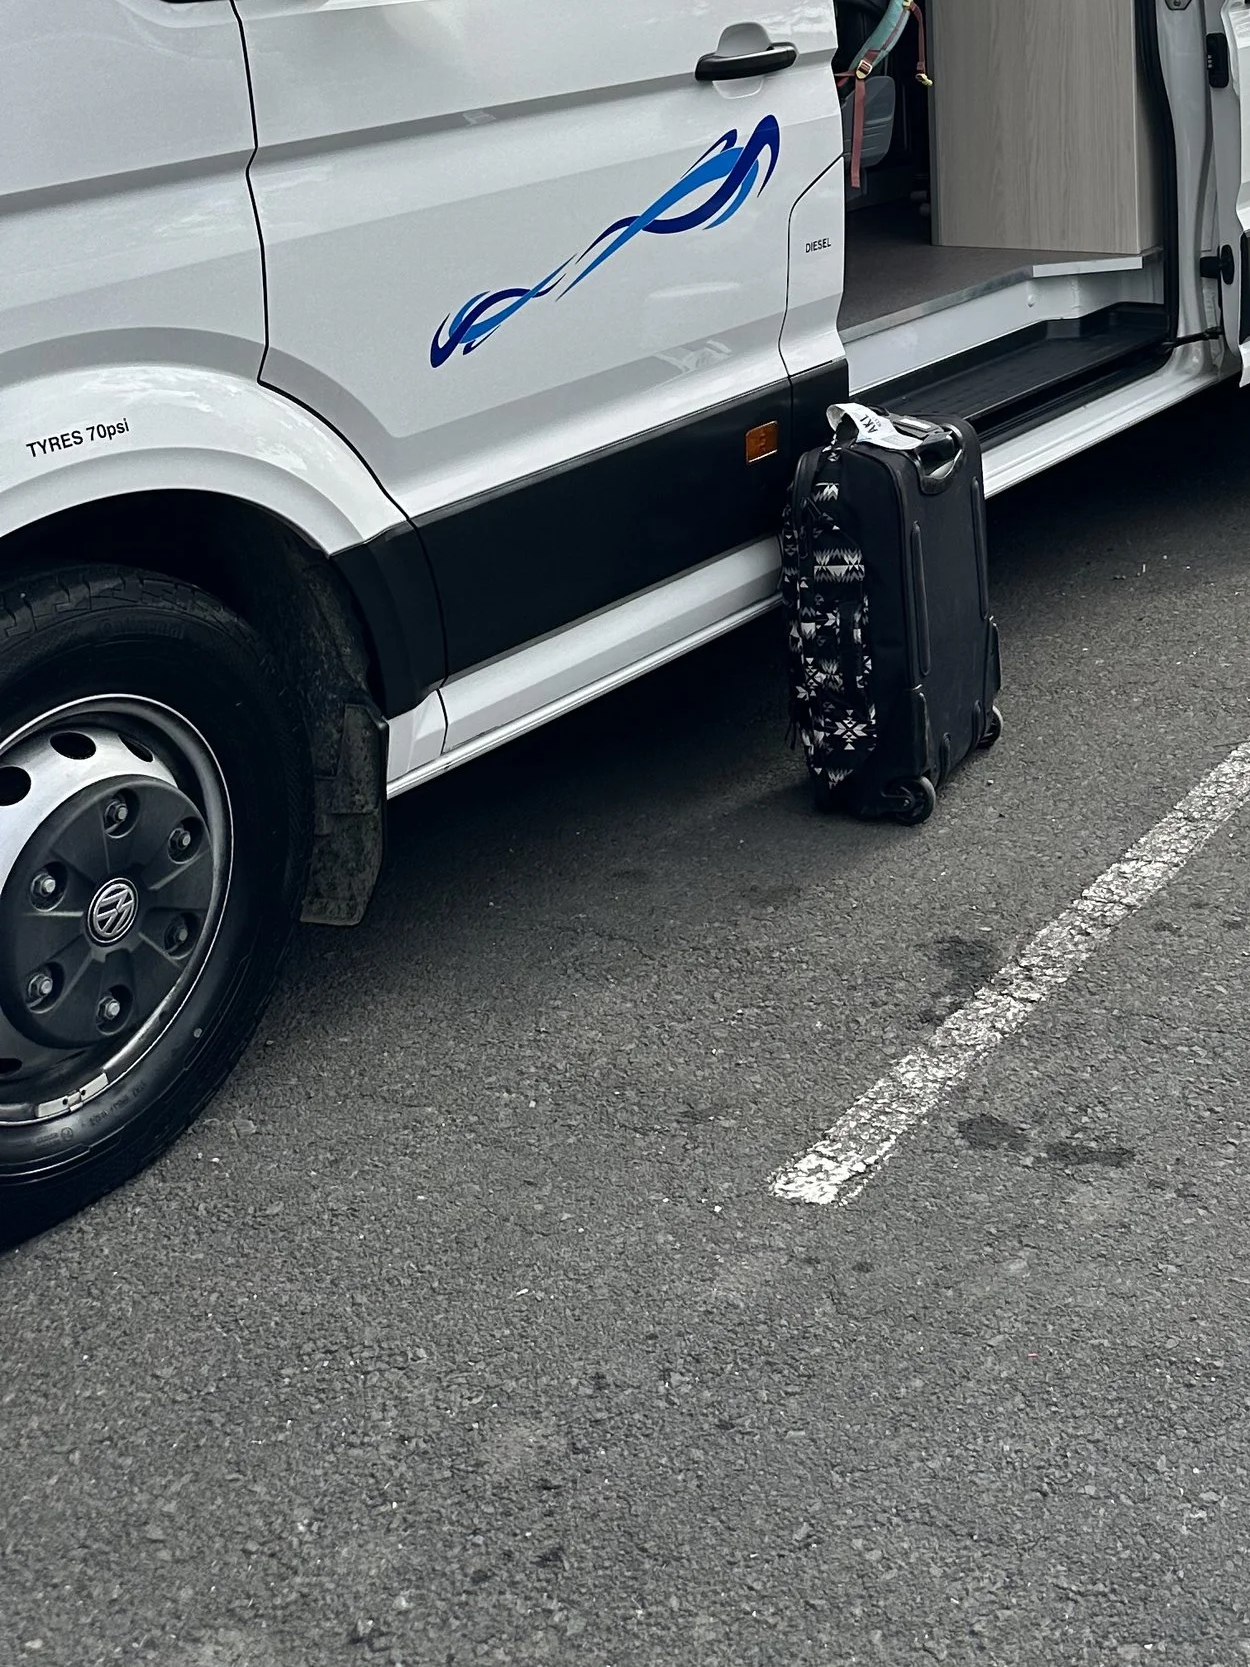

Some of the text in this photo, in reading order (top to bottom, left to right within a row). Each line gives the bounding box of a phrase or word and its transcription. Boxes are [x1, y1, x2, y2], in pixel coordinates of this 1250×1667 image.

[805, 237, 832, 253] DIESEL
[26, 418, 130, 458] TYRES 70psi
